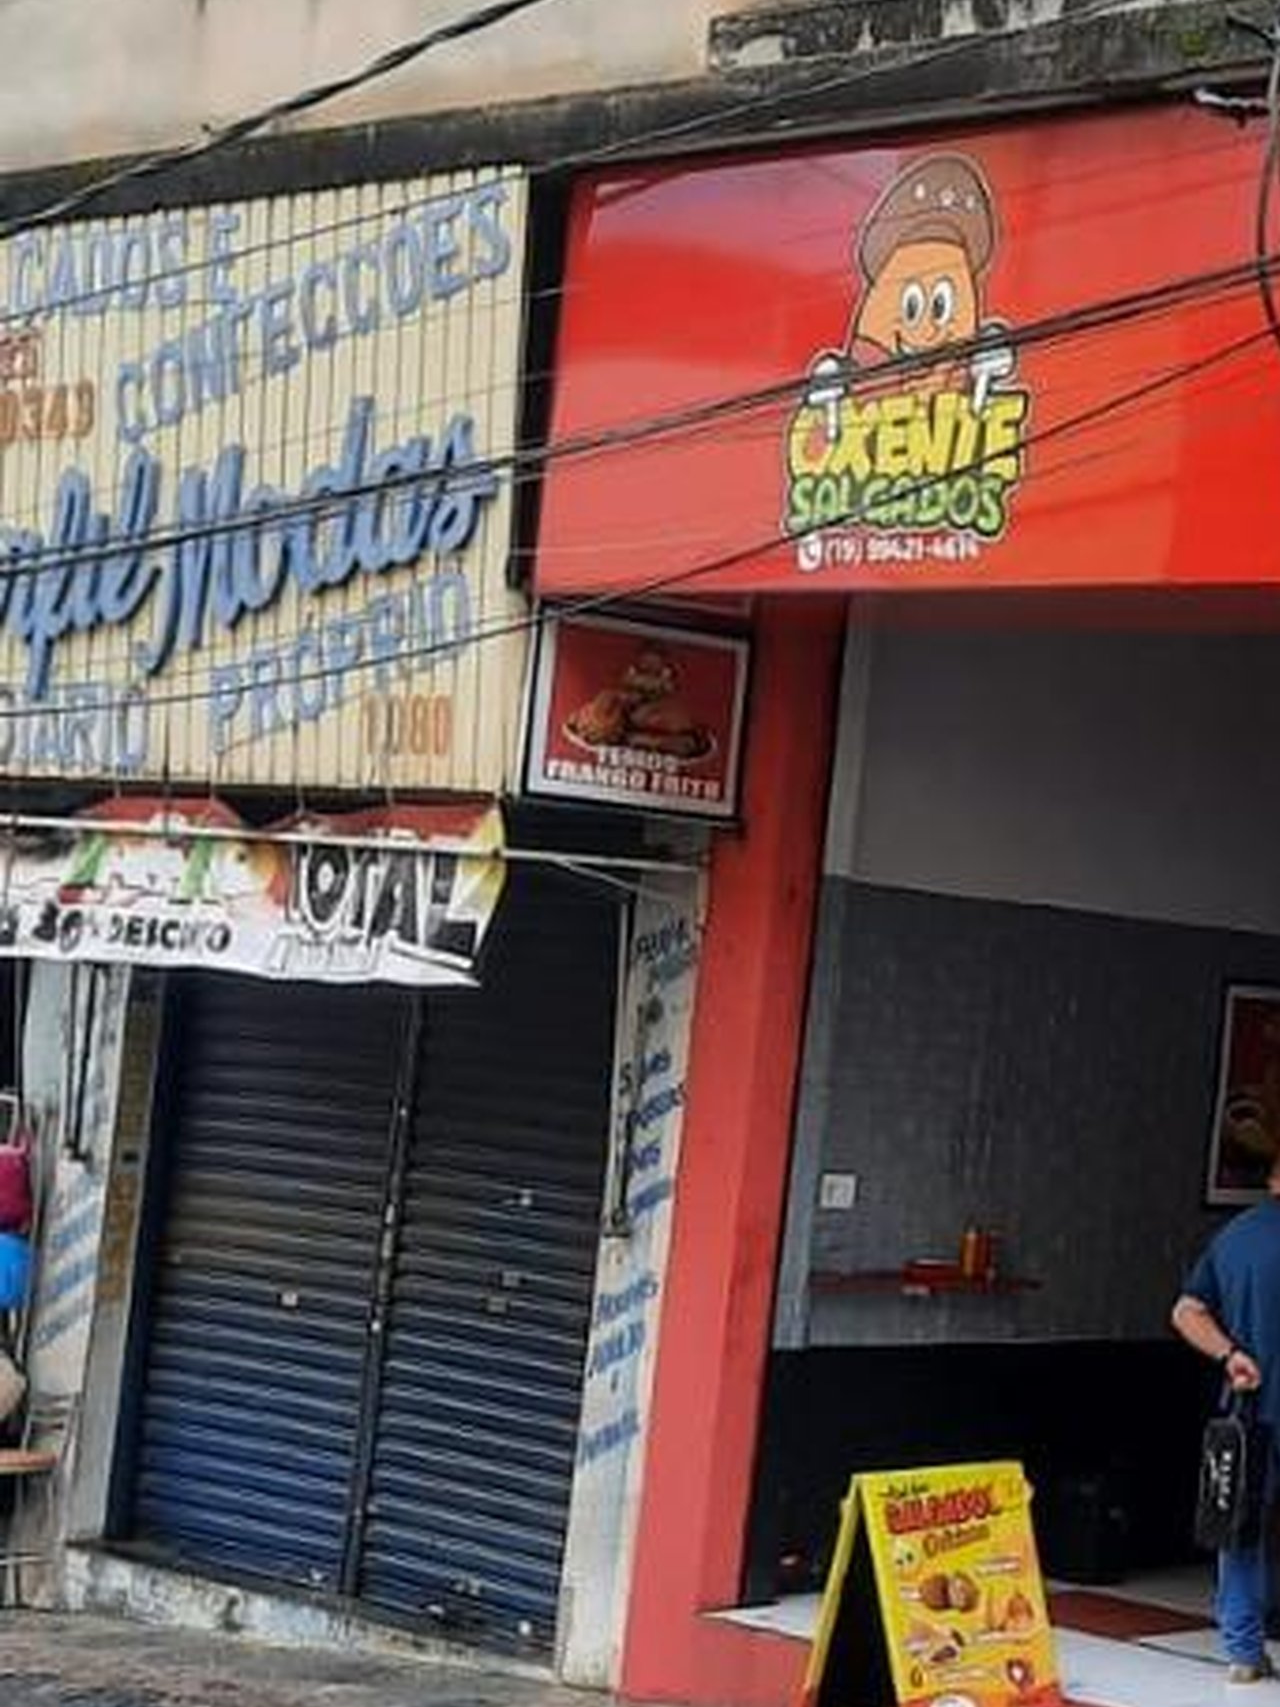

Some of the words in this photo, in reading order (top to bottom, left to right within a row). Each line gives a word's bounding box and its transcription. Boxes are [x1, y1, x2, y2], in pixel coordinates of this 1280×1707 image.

[790, 393, 1027, 483] OXENTE
[133, 394, 499, 676] Modas
[788, 472, 1006, 537] SALGADOS
[108, 913, 232, 954] DESCO
